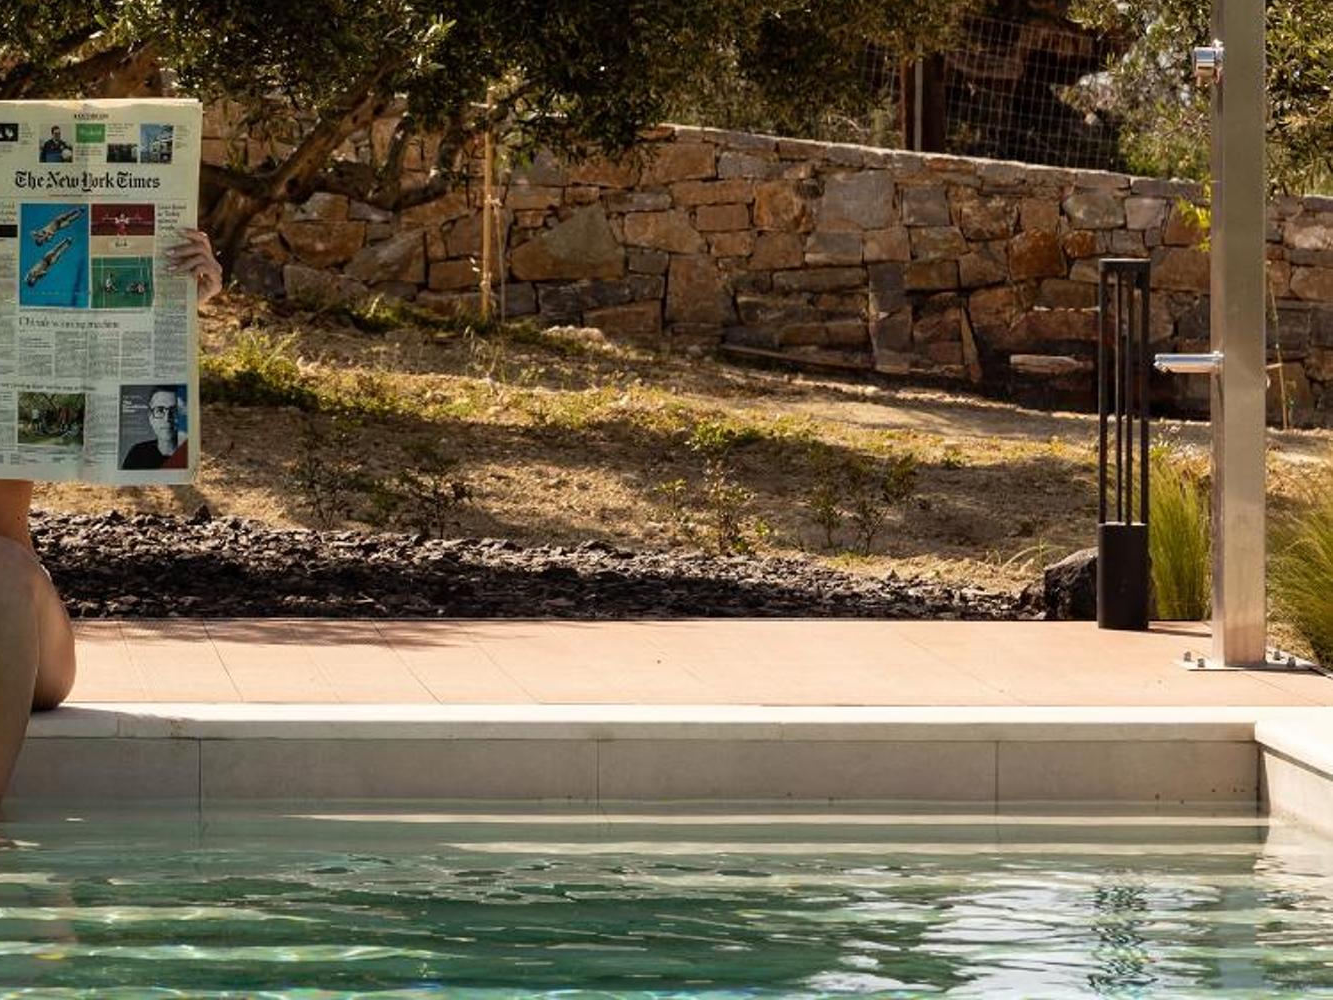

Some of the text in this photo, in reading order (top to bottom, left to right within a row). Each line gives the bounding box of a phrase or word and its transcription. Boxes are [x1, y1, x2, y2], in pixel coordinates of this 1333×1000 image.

[15, 170, 161, 192] The New York Times
